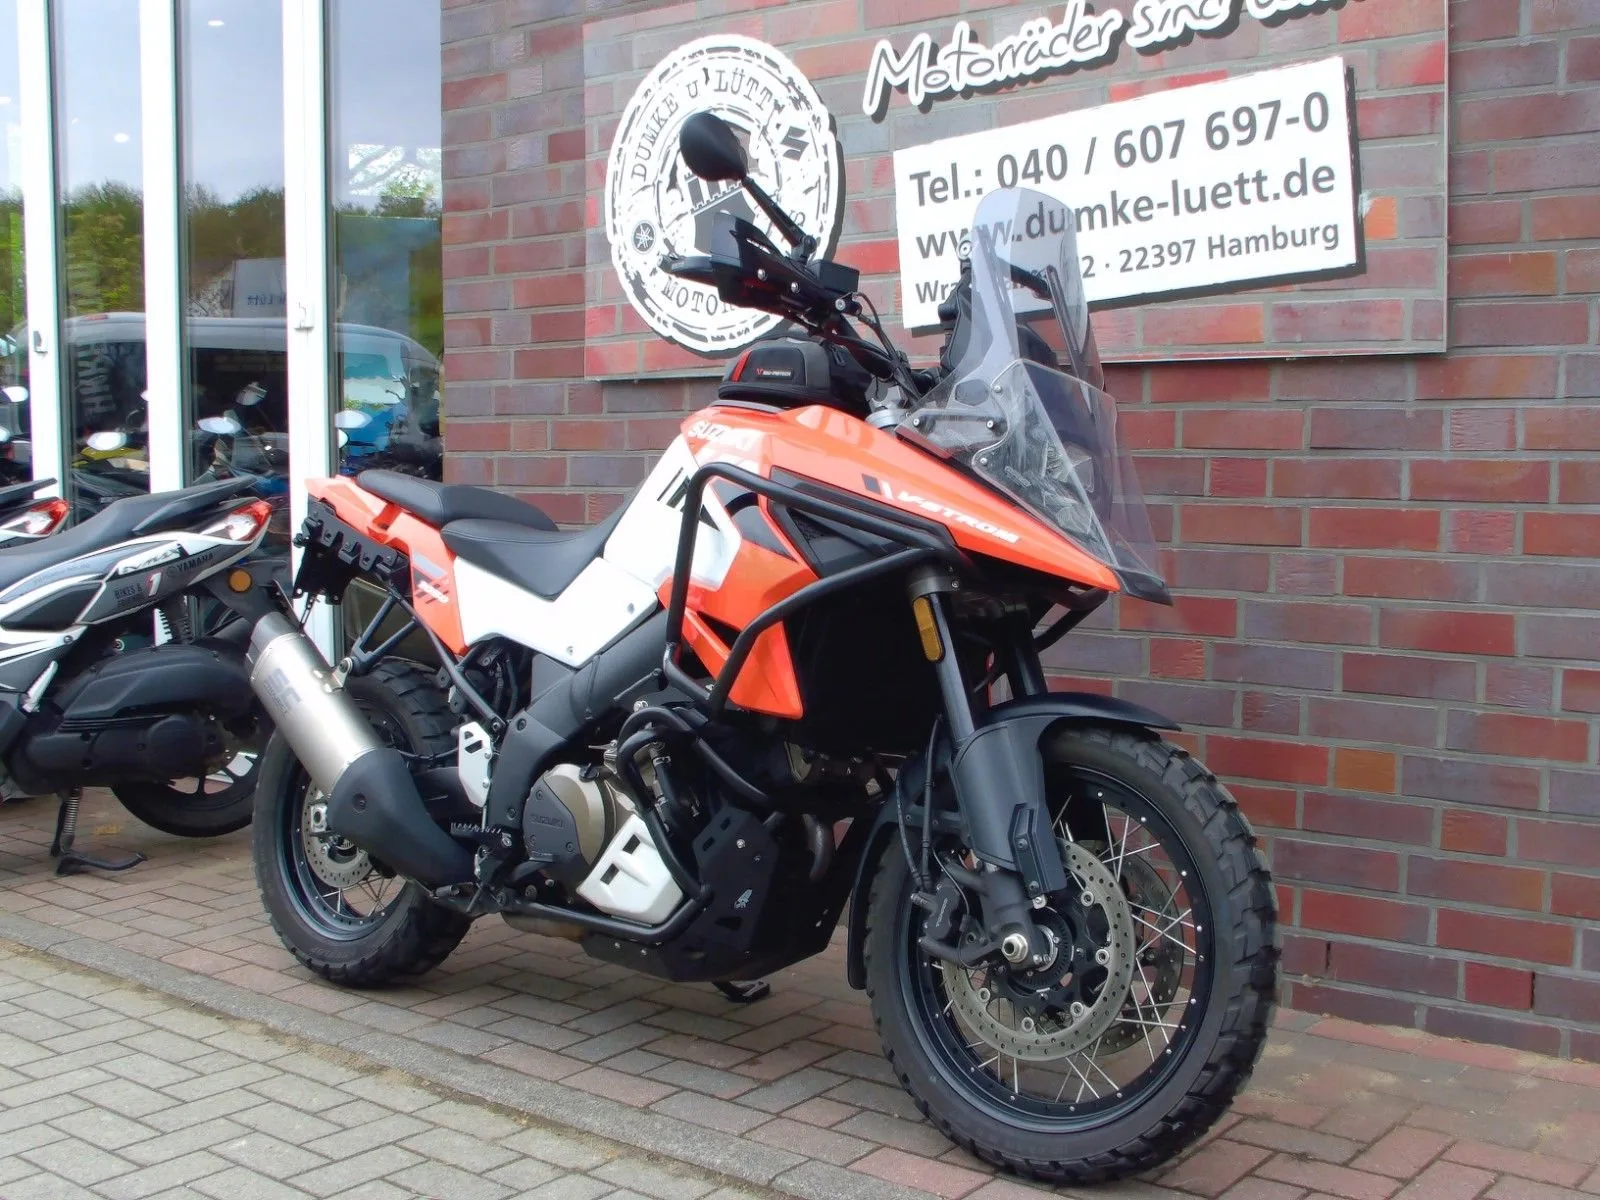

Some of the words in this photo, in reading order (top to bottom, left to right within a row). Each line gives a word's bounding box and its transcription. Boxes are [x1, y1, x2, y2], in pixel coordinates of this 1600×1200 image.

[867, 1, 1116, 109] Motorräder
[631, 92, 680, 182] DUMKE
[909, 162, 983, 207] Tel.:
[997, 144, 1068, 189] 040
[1084, 136, 1097, 175] /
[1114, 119, 1185, 168] 607
[1205, 91, 1329, 151] 697-0
[1119, 239, 1196, 273] 22397
[1207, 223, 1339, 260] Hamburg
[897, 490, 1021, 544] V-STROM
